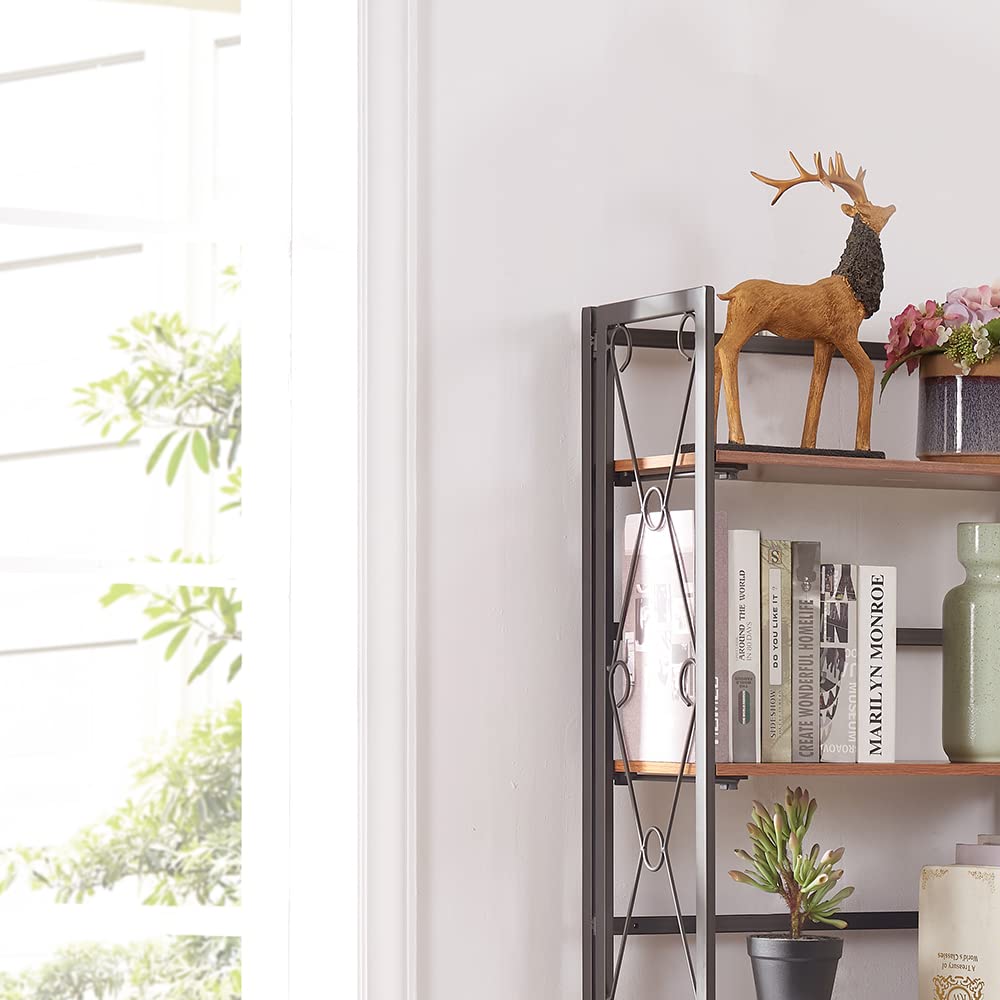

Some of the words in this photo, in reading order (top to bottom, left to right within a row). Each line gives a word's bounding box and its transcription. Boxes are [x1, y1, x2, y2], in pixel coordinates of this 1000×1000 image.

[738, 569, 746, 601] WORLD
[772, 594, 778, 605] IT
[738, 604, 746, 621] THE
[798, 599, 814, 650] HOMELIFE
[869, 574, 885, 659] MONROE
[738, 624, 746, 661] AROUND
[772, 648, 778, 669] DO
[798, 654, 814, 718] WONDERFUL
[869, 665, 883, 756] MARILYN
[798, 721, 814, 758] CREATE
[937, 952, 959, 962] Classics
[948, 961, 971, 971] Treasury
[959, 953, 979, 962] World's
